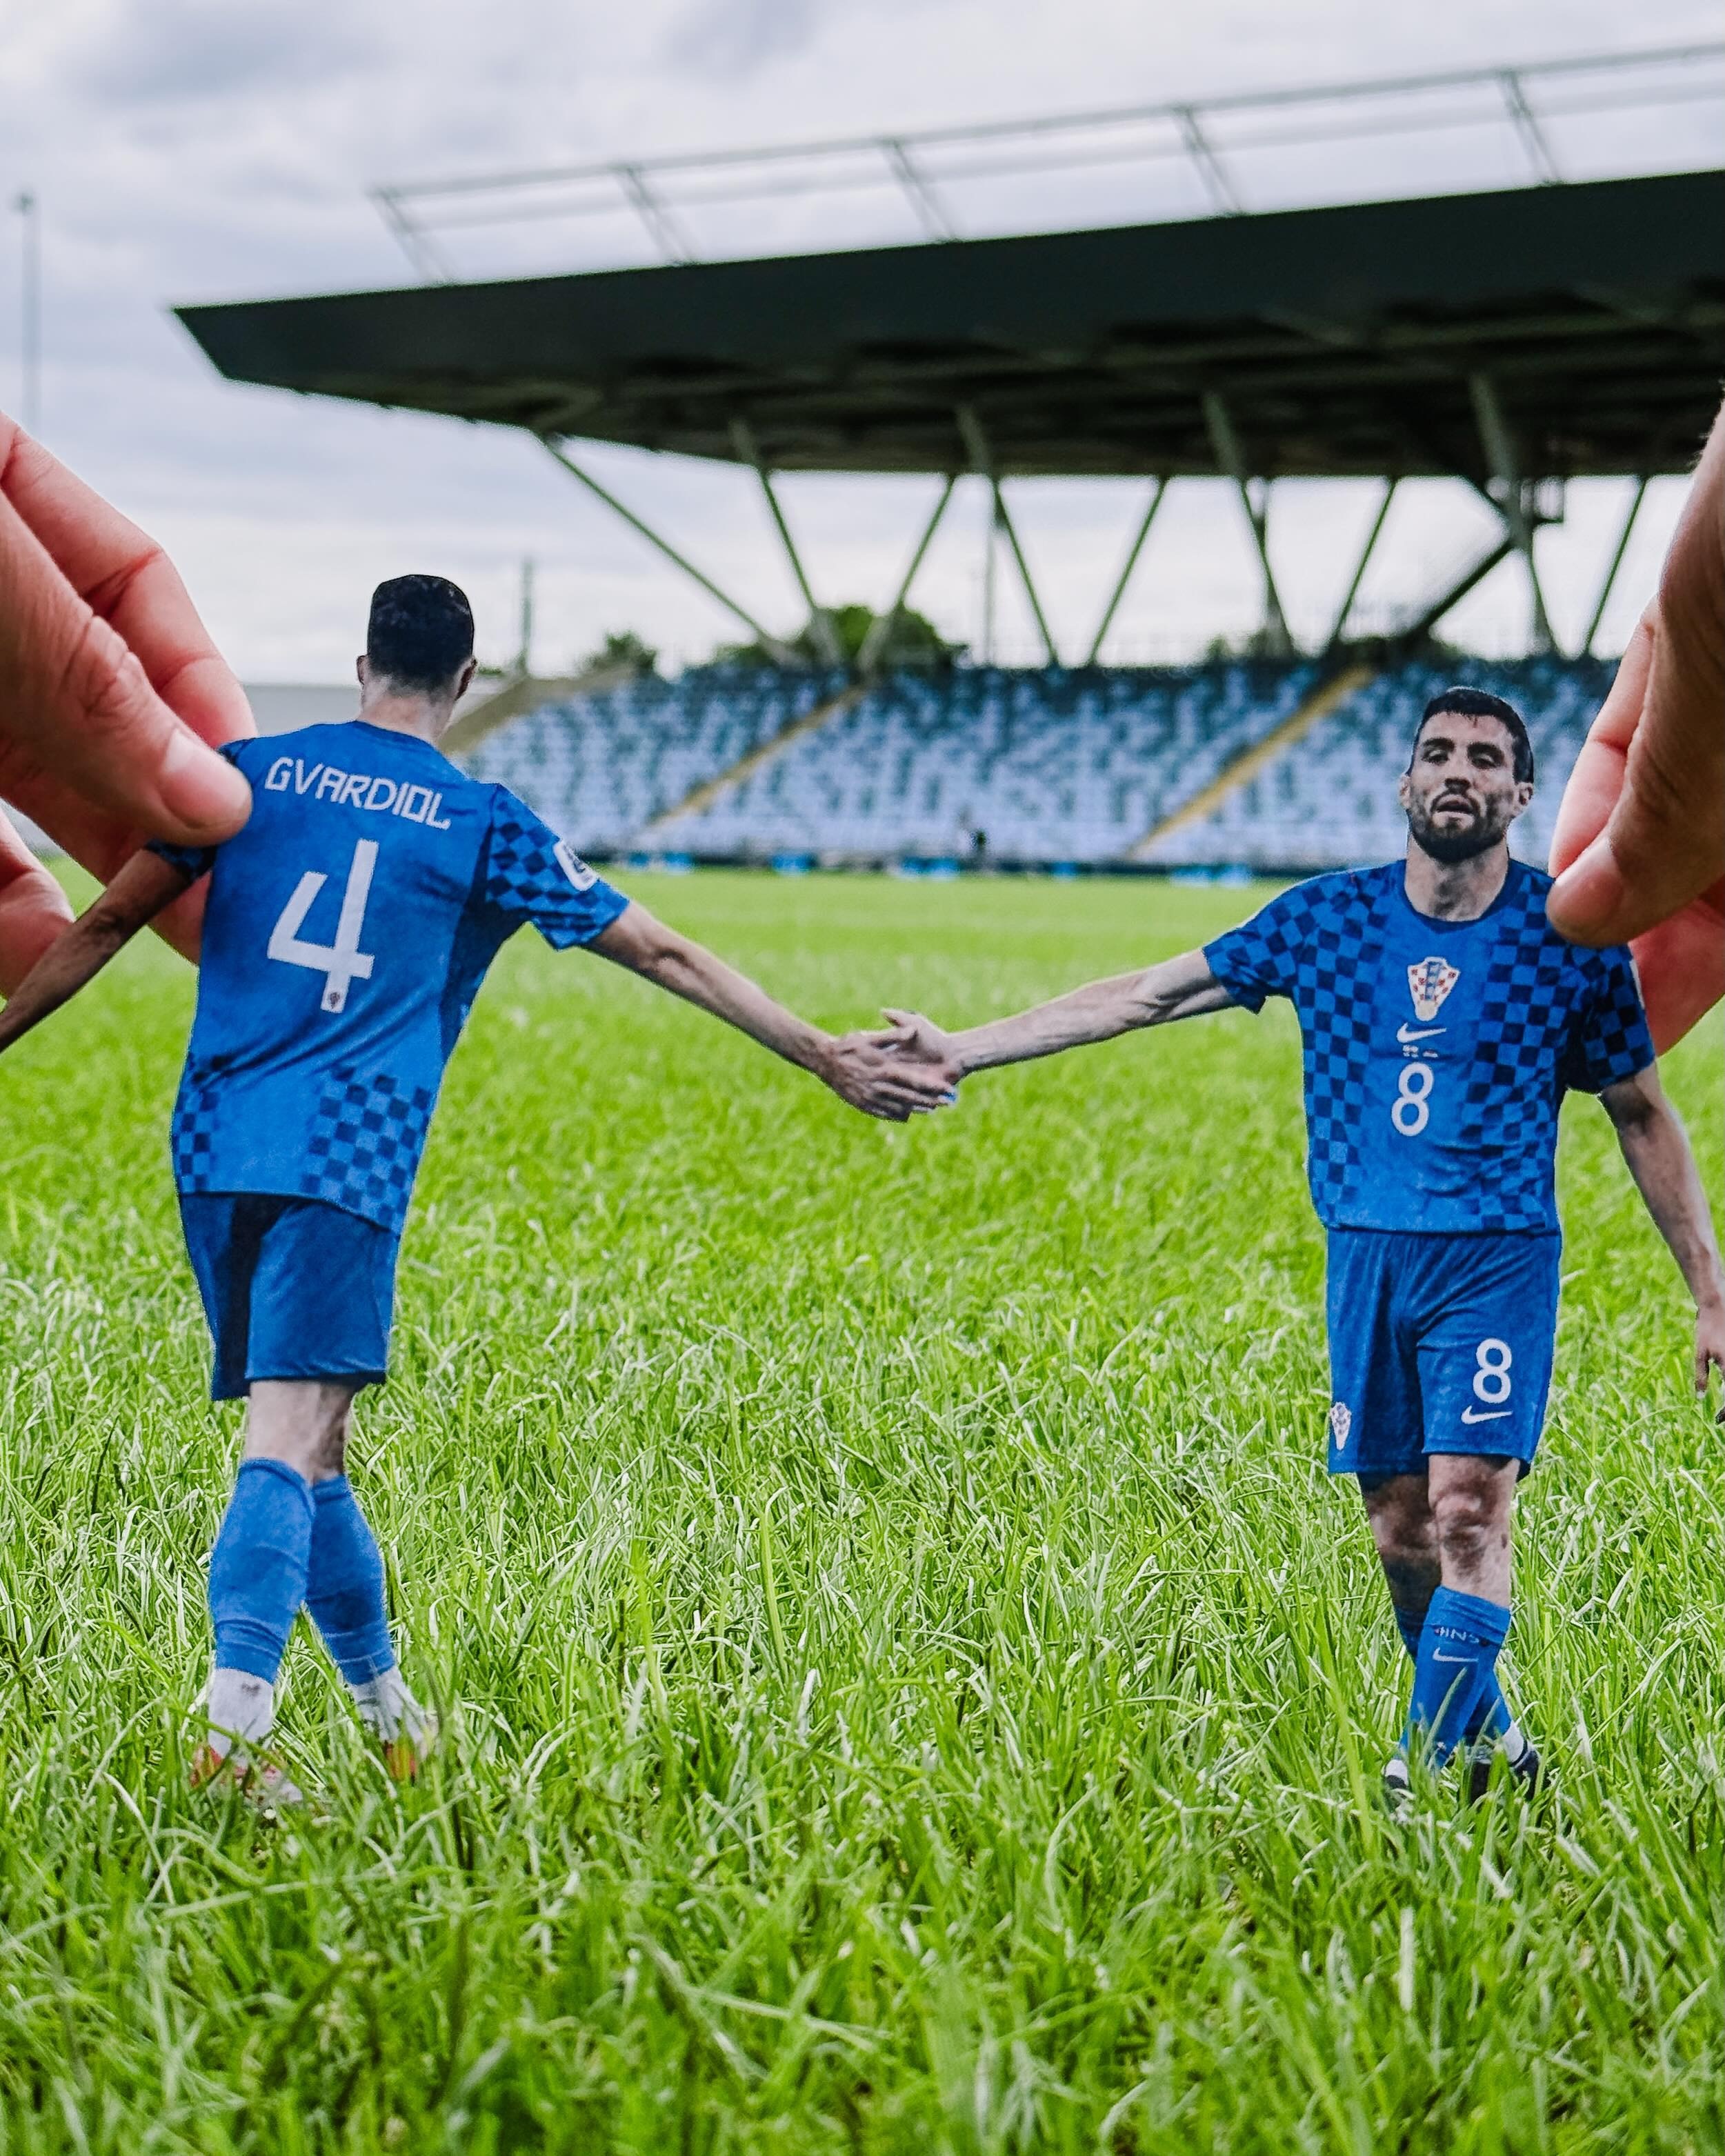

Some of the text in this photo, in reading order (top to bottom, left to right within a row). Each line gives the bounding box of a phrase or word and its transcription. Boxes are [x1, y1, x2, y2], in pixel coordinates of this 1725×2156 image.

[265, 757, 452, 830] GVARDIOL
[267, 839, 379, 1014] 4
[1391, 1062, 1434, 1137] 8
[1473, 1337, 1512, 1404] 8
